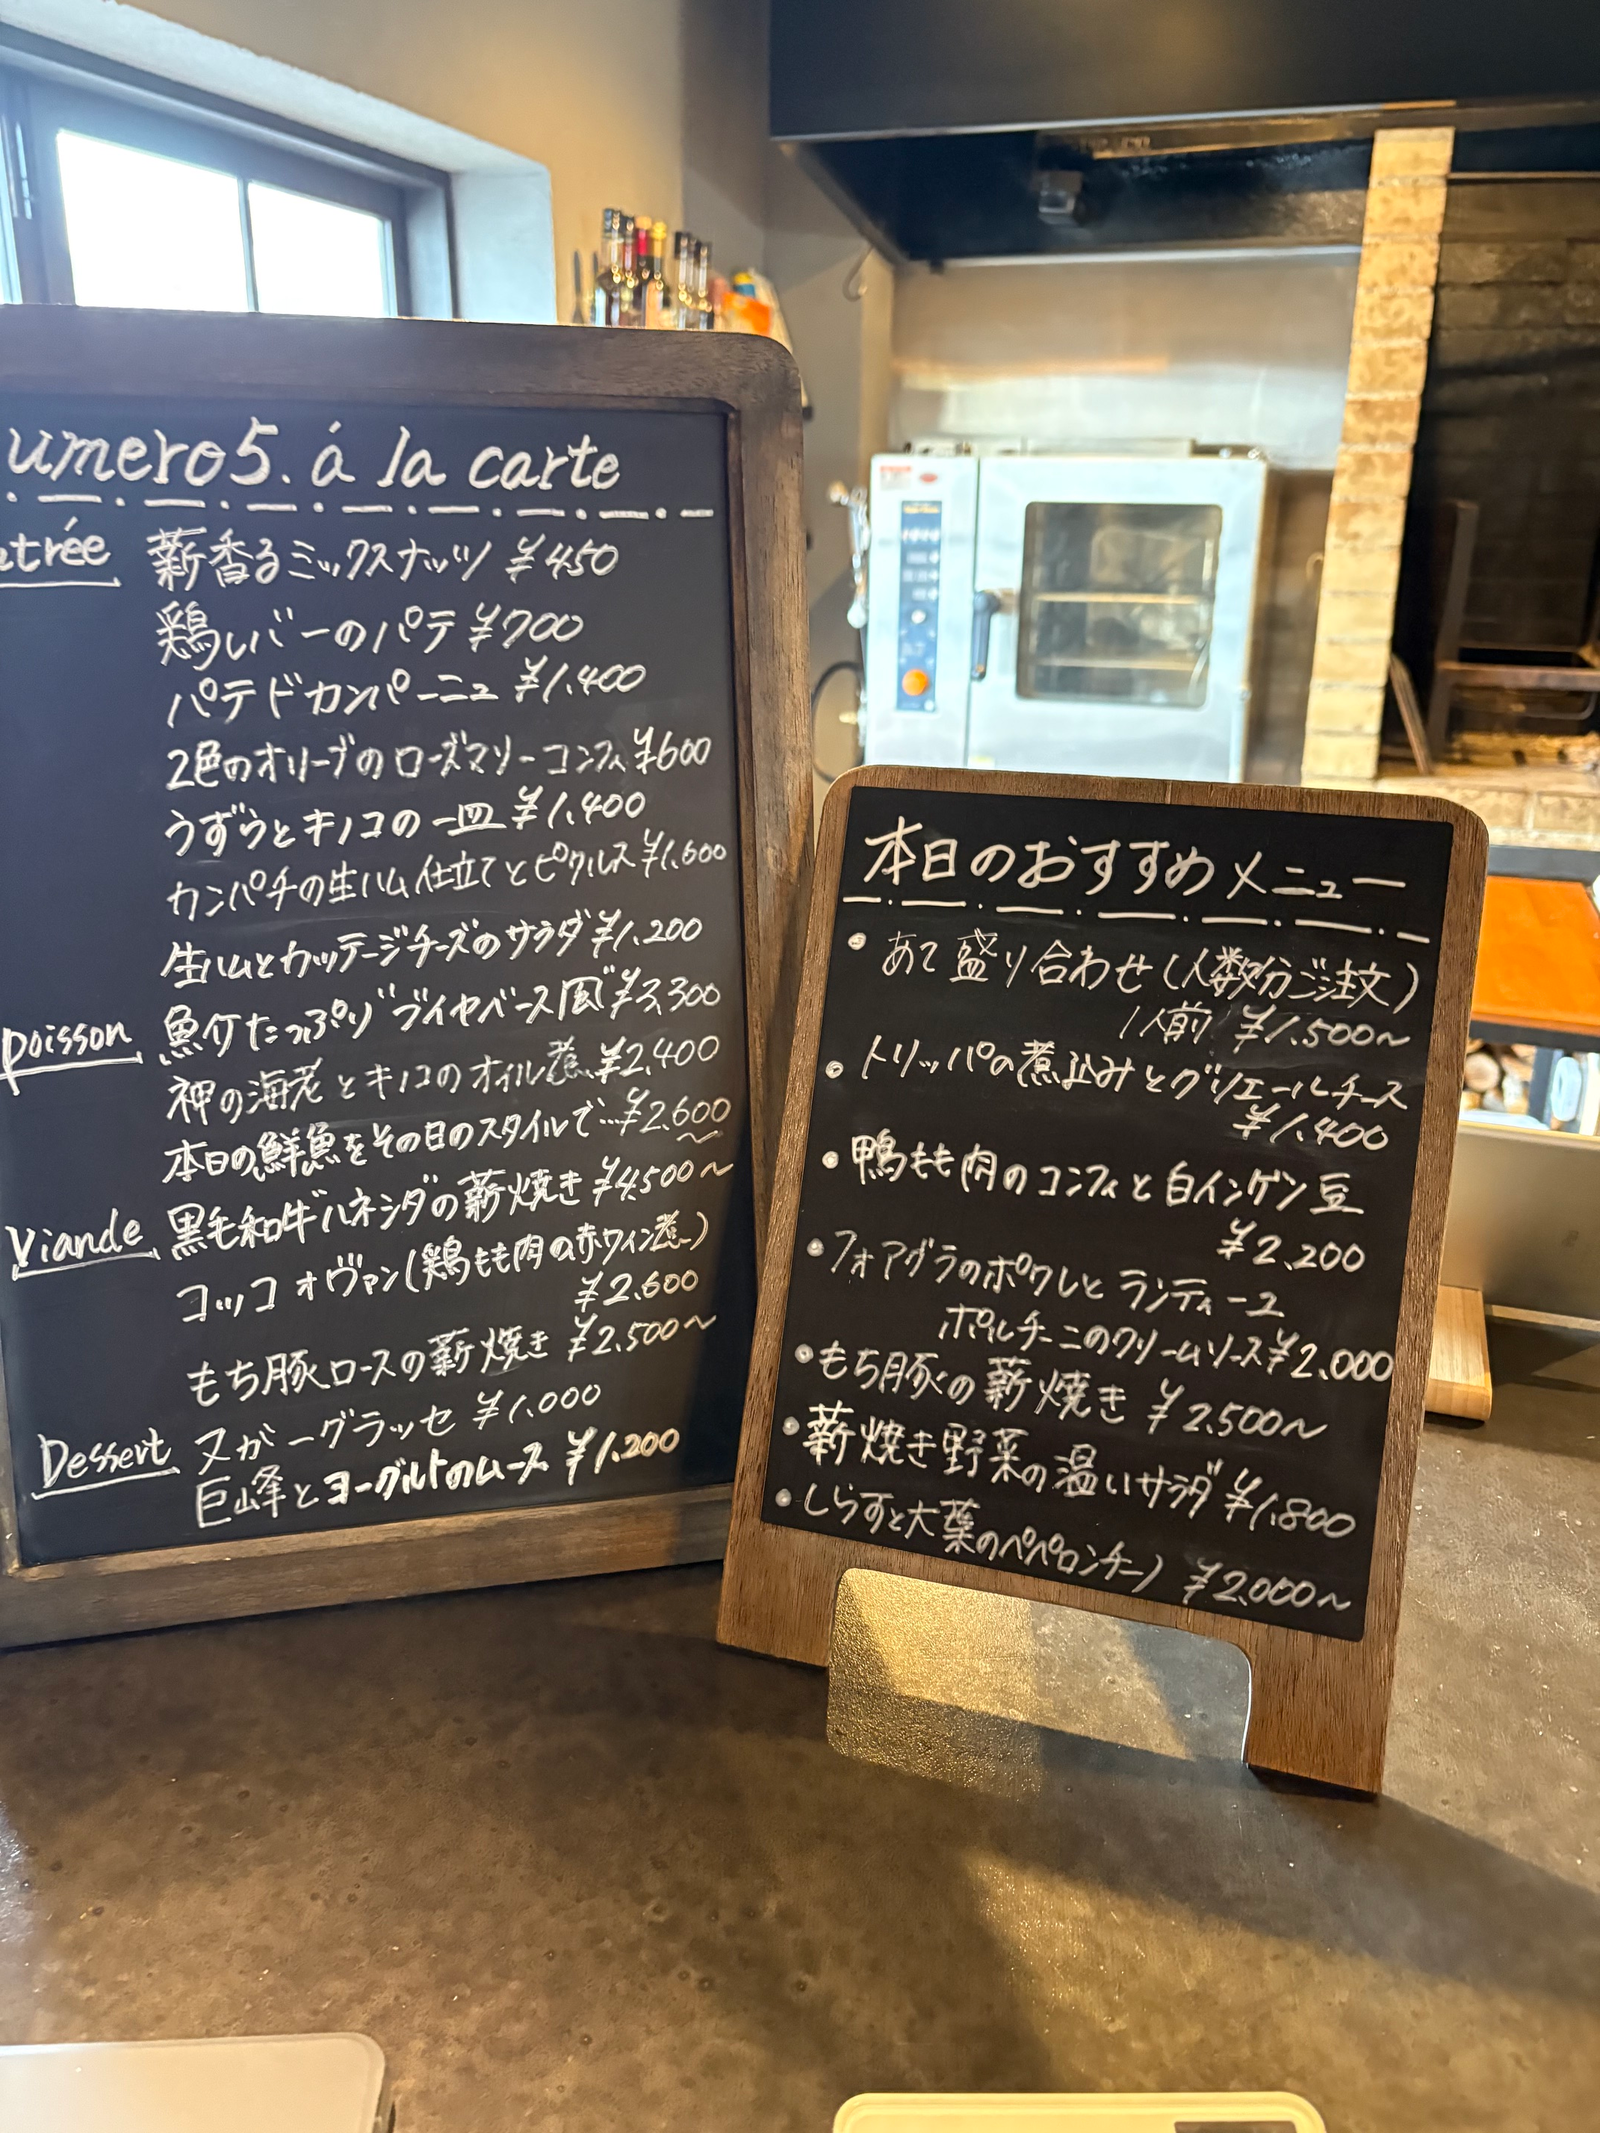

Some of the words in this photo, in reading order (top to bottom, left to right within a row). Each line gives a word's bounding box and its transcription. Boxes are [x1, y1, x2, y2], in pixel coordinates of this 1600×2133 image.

[375, 426, 447, 488] la
[468, 434, 621, 491] carte
[147, 526, 492, 592] 薪香るミックスナッツ
[504, 533, 619, 583] ¥450
[156, 601, 456, 671] 鶏レバーのパテ
[468, 602, 584, 652] ¥700
[633, 726, 712, 775] ¥600
[166, 841, 636, 922] カンパチの生ハム仕立てとピクルス
[864, 815, 1406, 900] 本日のおすすめメニュー
[160, 909, 592, 988] 生ハムとカッテージチーズのサラダ
[851, 1128, 1365, 1215] 鴨もも肉のコンフィと白インゲン豆
[5, 1208, 144, 1267] Viande
[187, 1325, 549, 1407] もち豚ロースの薪焼き
[938, 1303, 1262, 1368] ポルチーニのクリームソース
[819, 1340, 1127, 1424] もち豚の薪焼き
[37, 1427, 171, 1489] Dessert
[802, 1400, 1225, 1519] 薪焼き野菜の温いサラダ
